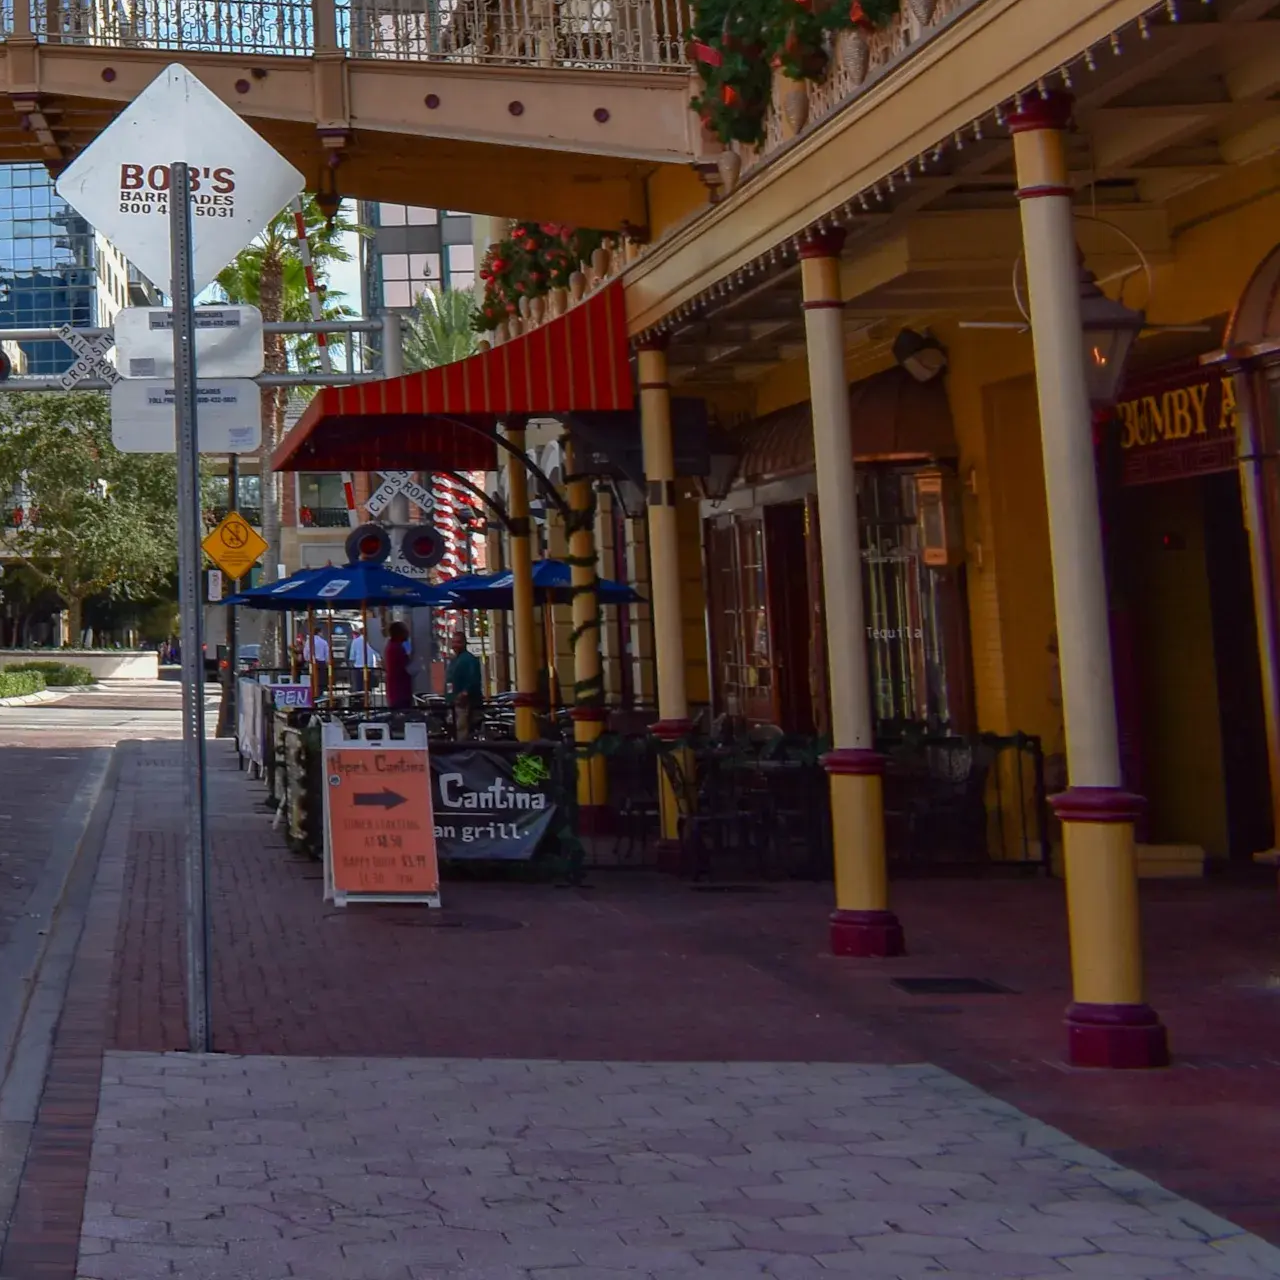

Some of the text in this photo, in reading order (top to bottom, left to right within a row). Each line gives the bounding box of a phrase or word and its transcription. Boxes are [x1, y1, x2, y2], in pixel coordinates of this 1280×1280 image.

[119, 202, 152, 214] 800
[195, 206, 234, 218] 5031
[120, 191, 235, 206] BARRADES
[59, 324, 90, 356] RAIL
[61, 332, 116, 388] CROSSIN
[1116, 382, 1210, 449] BUMBY
[403, 481, 434, 509] ROAD
[866, 626, 924, 642] Tequila
[274, 689, 308, 706] PEN
[439, 772, 546, 810] Cantina
